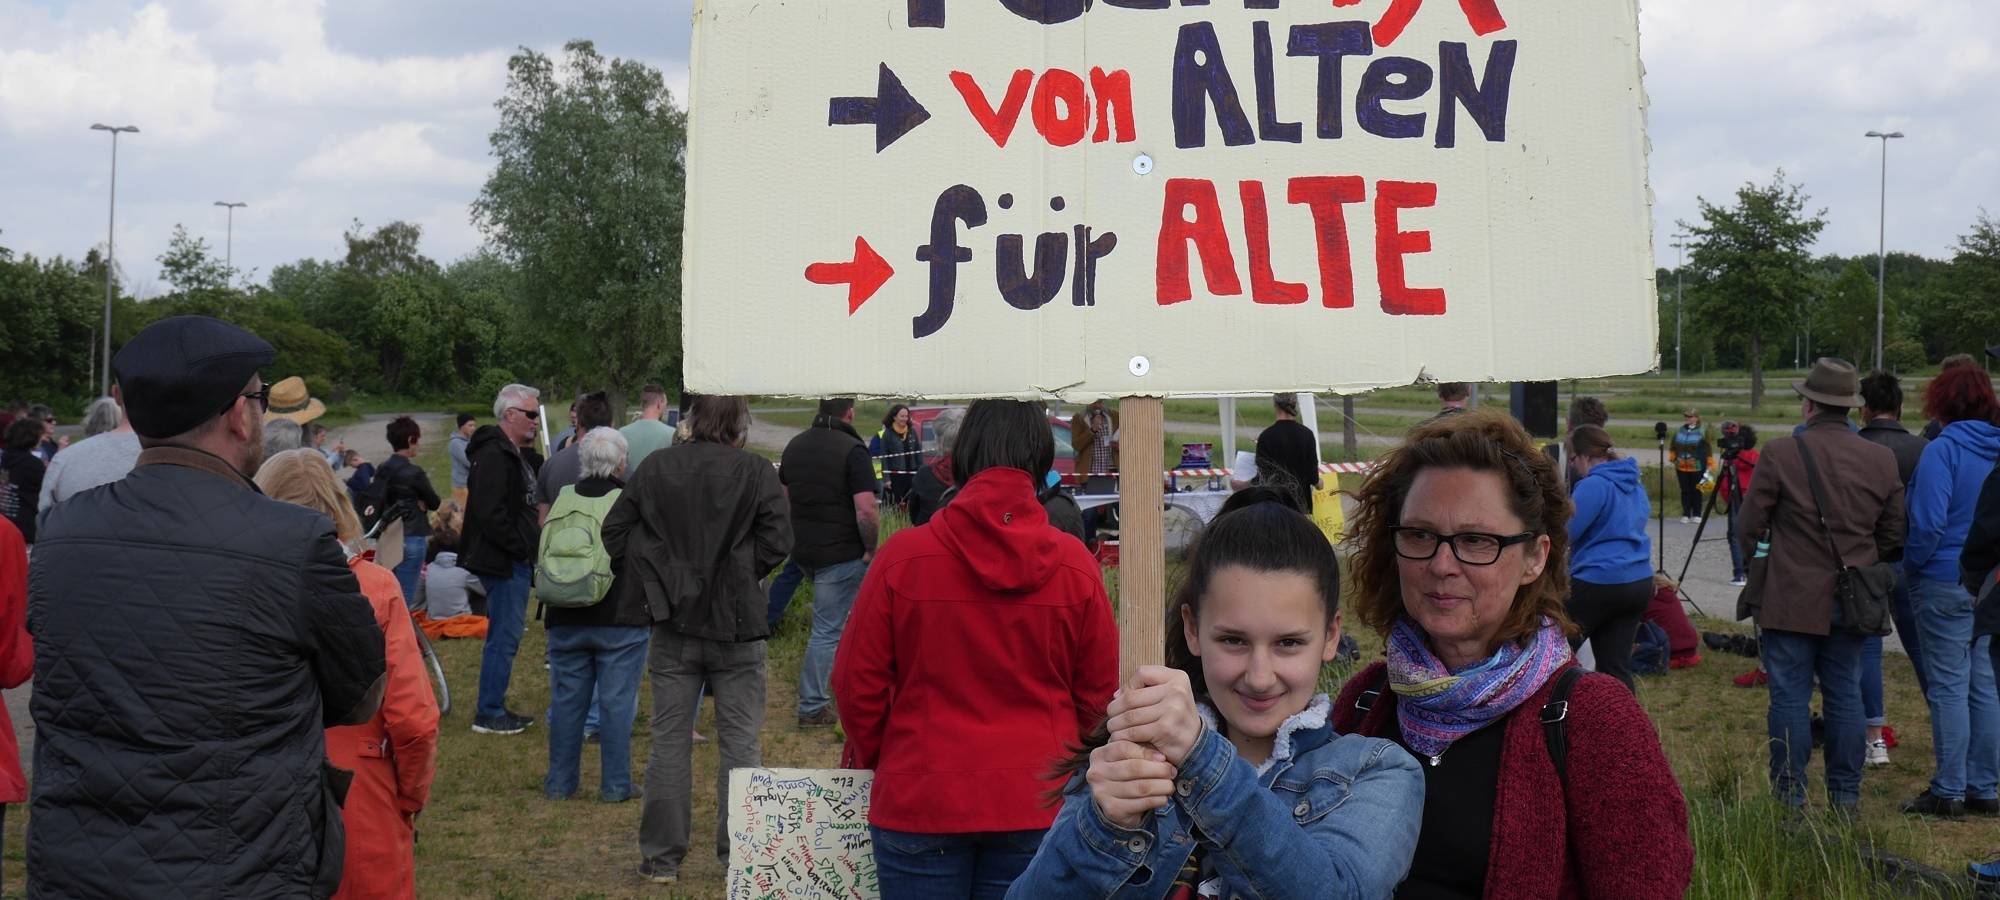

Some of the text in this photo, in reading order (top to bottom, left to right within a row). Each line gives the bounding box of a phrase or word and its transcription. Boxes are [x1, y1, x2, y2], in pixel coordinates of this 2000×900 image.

[949, 66, 1137, 148] von
[913, 174, 1447, 338] für ALTE
[741, 785, 761, 833] Sophie
[753, 788, 790, 807] Angela
[840, 779, 873, 806] arina
[815, 816, 833, 851] Paul
